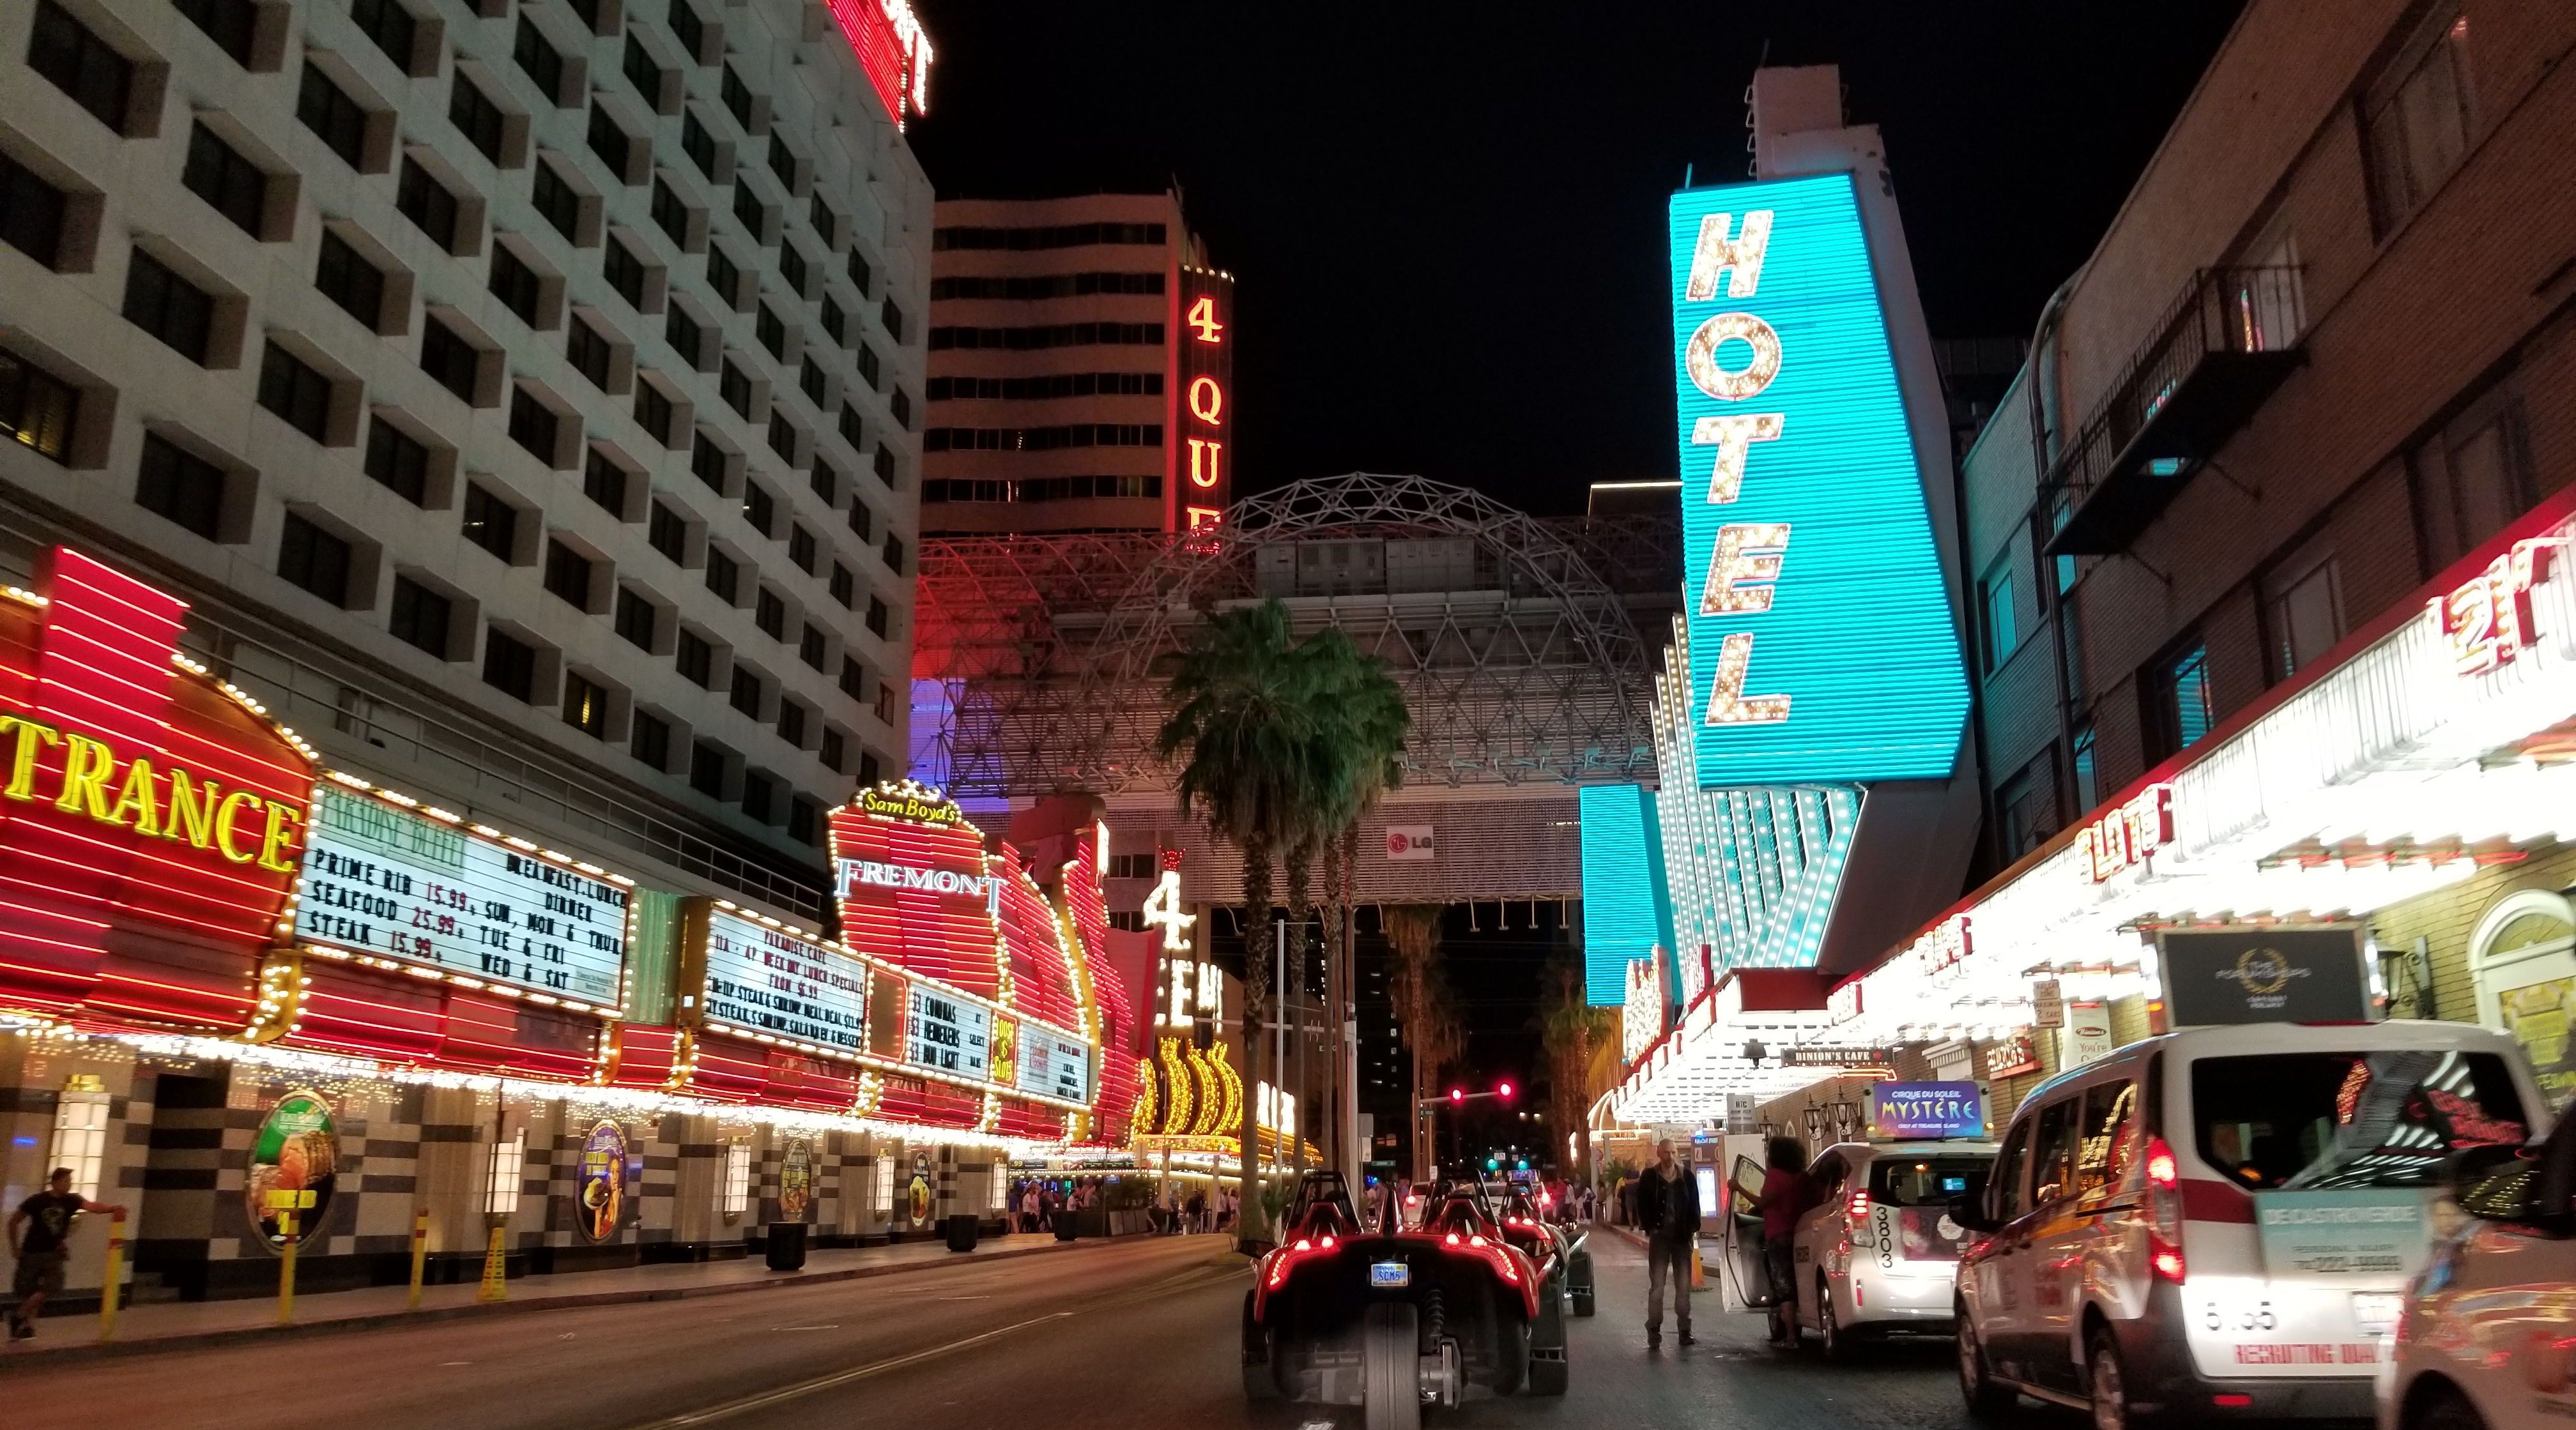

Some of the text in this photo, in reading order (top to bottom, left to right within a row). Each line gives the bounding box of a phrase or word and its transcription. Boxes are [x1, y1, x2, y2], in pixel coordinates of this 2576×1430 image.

[1188, 297, 1223, 343] 4
[1685, 209, 1791, 727] HOTEL
[0, 715, 300, 873] TRANCE
[865, 793, 956, 821] Sam Boyd's
[1412, 837, 1432, 849] LG
[314, 848, 375, 886] PRIME
[383, 869, 411, 895] RIB
[426, 882, 466, 911] 15.99
[527, 913, 555, 936] MON
[545, 892, 592, 923] DINNER
[833, 858, 1008, 917] FREMONT
[1142, 870, 1197, 950] 4
[314, 879, 397, 921] SEAFOOD
[412, 906, 454, 936] 25.99
[480, 925, 510, 951] TUE
[544, 943, 565, 964] FRI
[310, 910, 371, 946] STEAK
[391, 931, 431, 959] 15.99
[481, 952, 510, 977] WED
[546, 969, 569, 991] SAT
[996, 1018, 1015, 1047] LOOSE
[2079, 1042, 2108, 1053] You're
[994, 1055, 1013, 1081] SLOTS
[1891, 1090, 1962, 1100] CIRQUE DU SOLEIL
[1876, 1206, 1893, 1268] 3803
